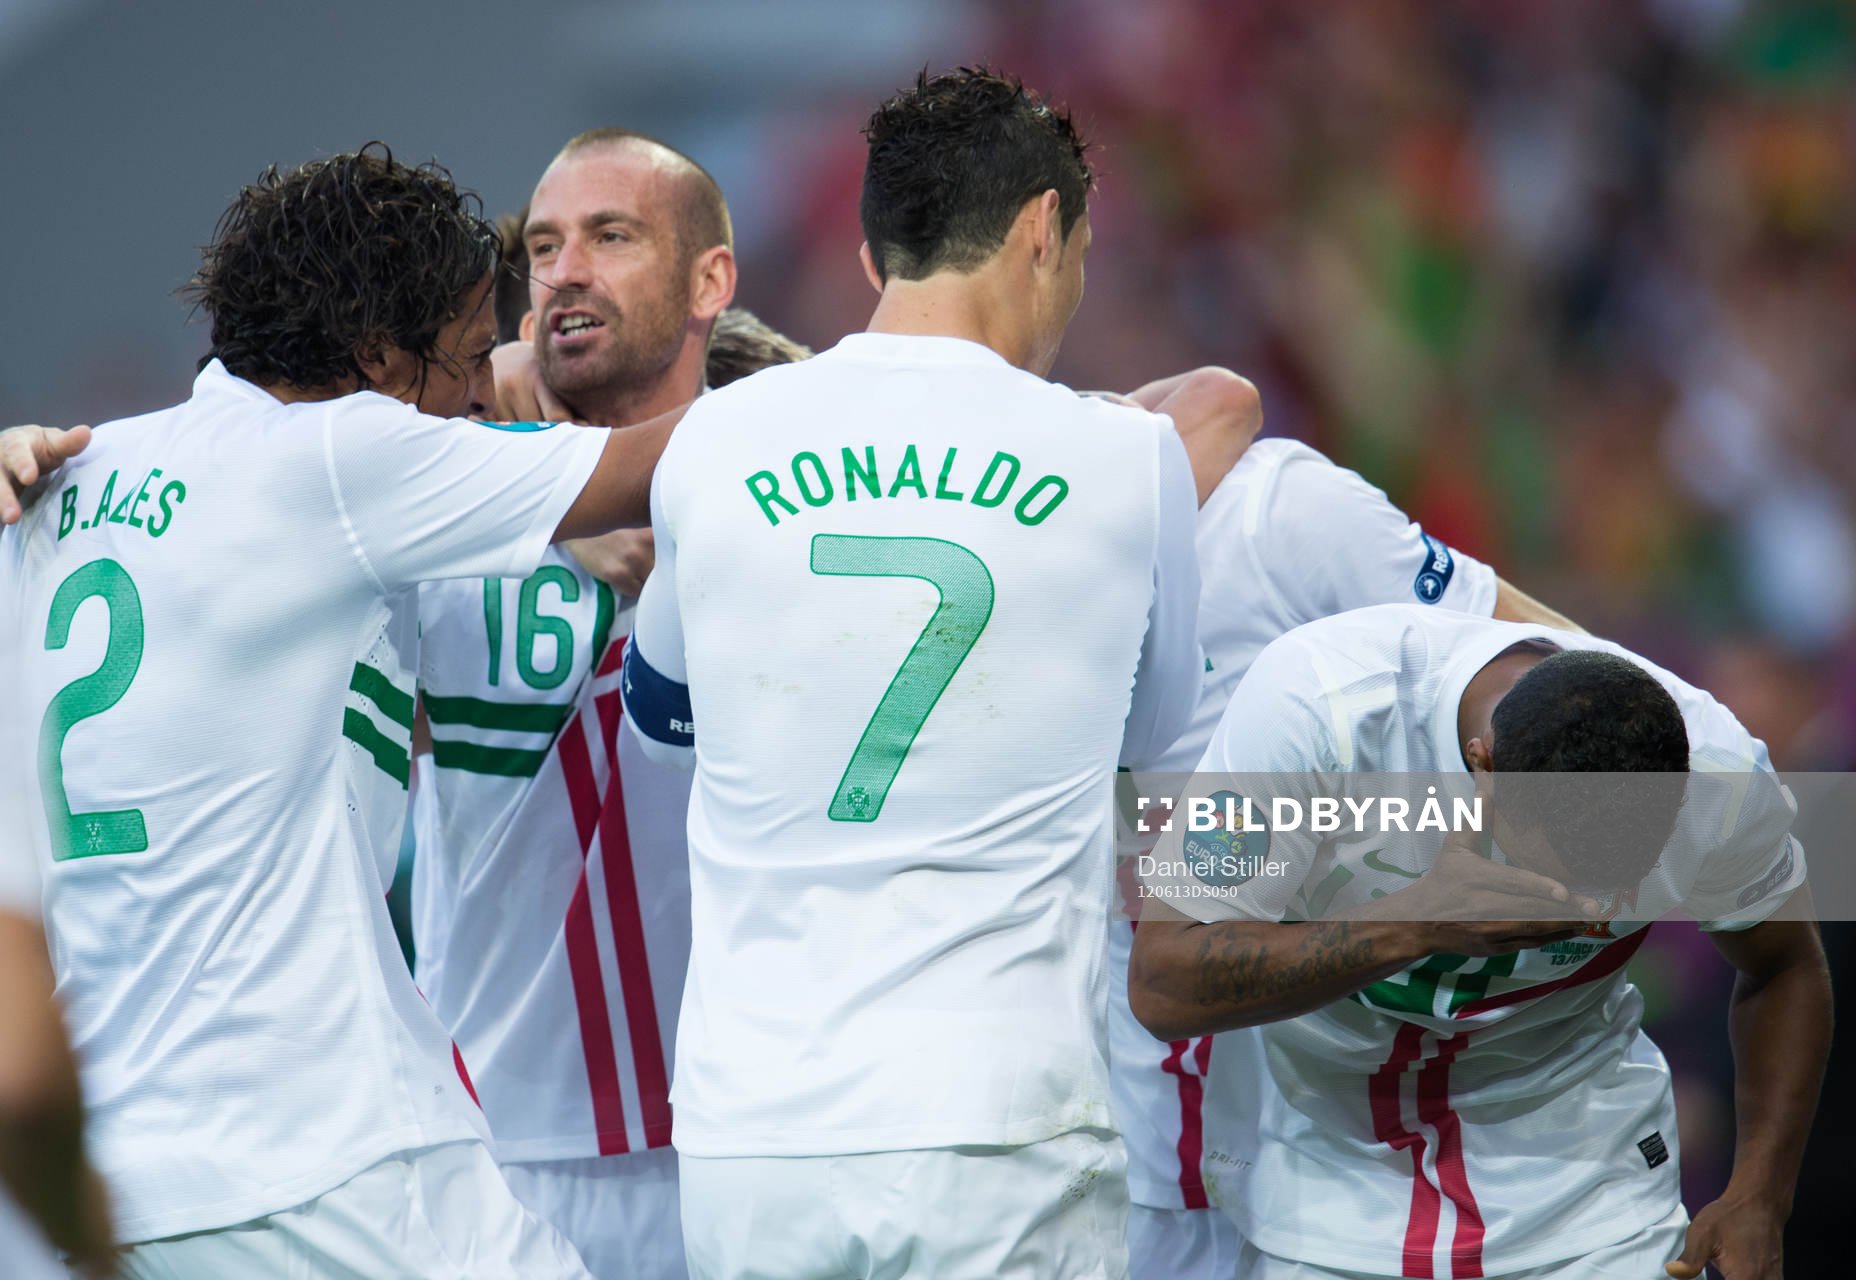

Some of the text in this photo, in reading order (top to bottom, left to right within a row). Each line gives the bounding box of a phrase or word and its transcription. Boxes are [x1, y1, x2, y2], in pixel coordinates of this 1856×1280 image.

[57, 467, 187, 542] B.ALES
[744, 444, 1070, 527] RONALDO
[483, 564, 581, 691] 16
[810, 533, 995, 823] 7
[36, 557, 149, 862] 2
